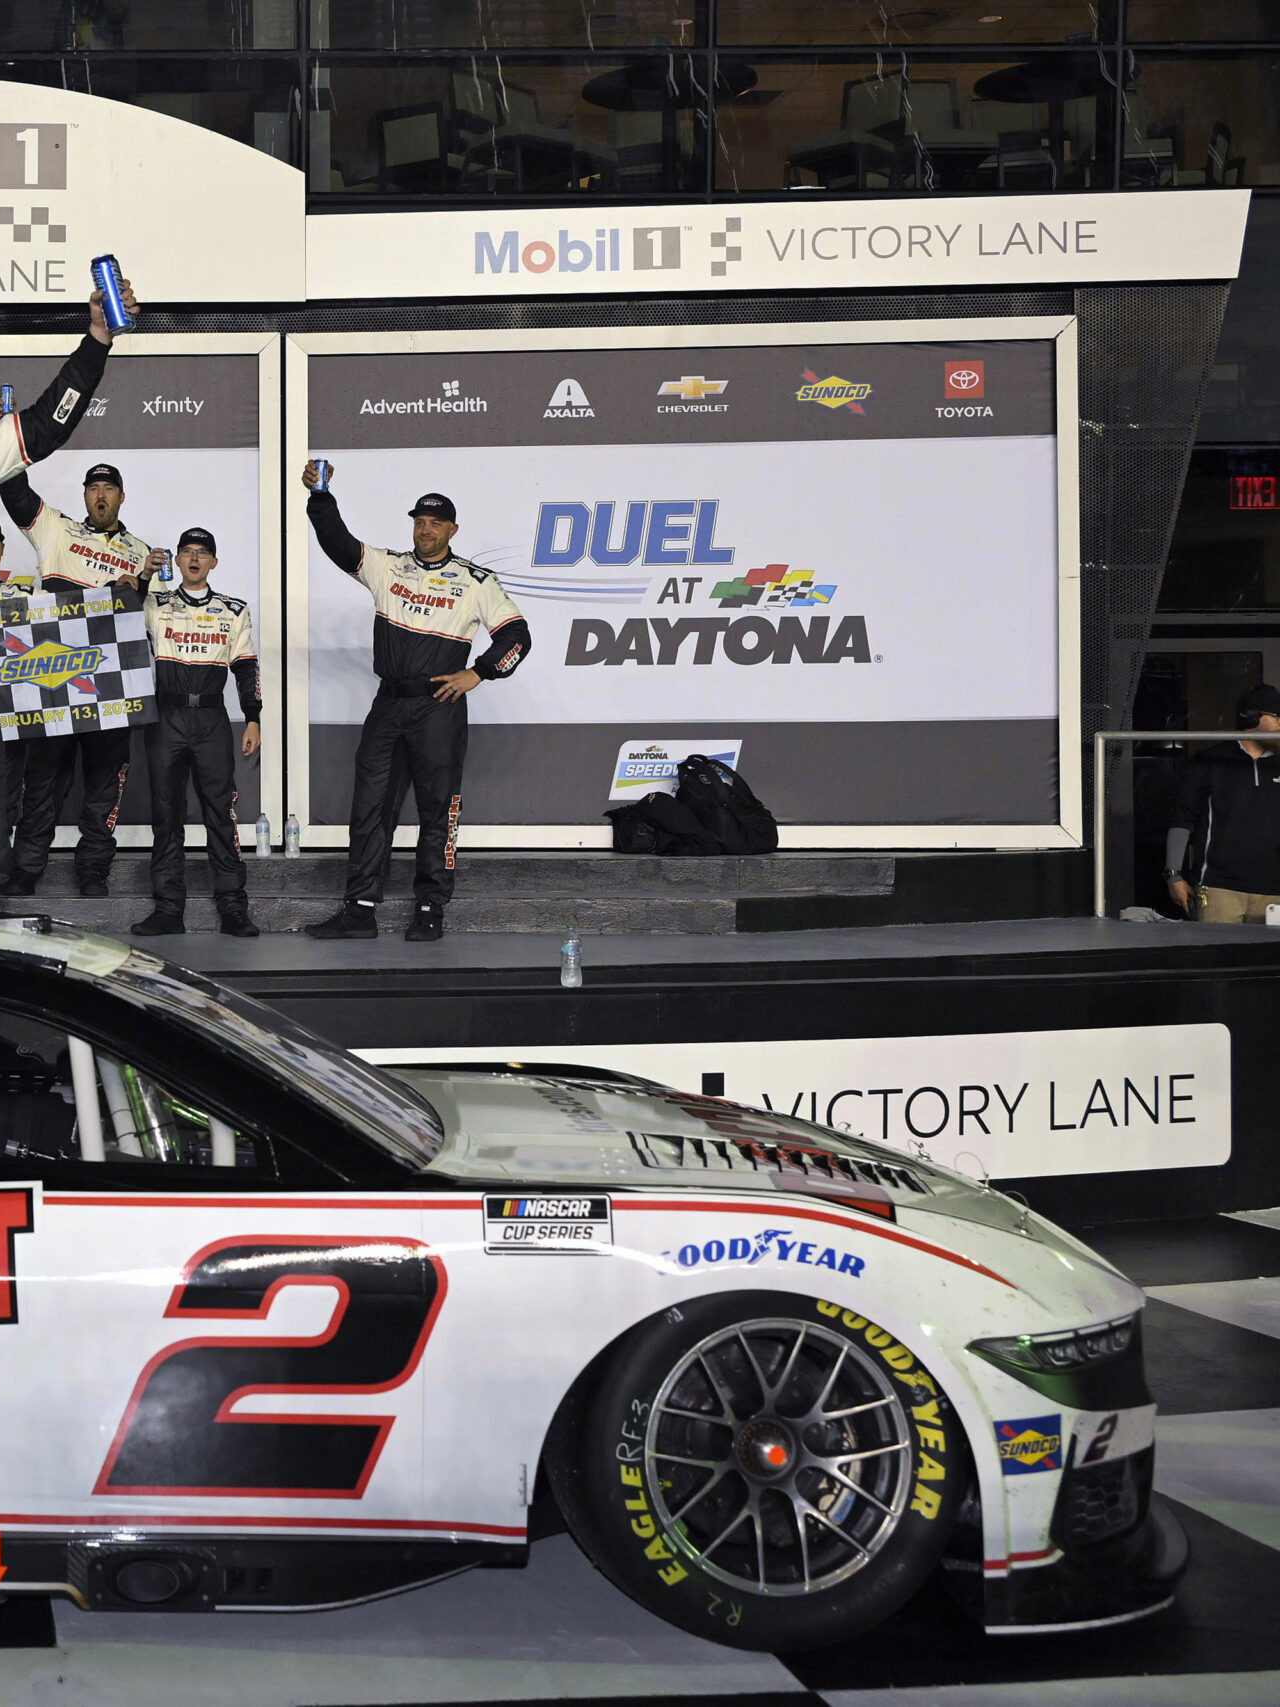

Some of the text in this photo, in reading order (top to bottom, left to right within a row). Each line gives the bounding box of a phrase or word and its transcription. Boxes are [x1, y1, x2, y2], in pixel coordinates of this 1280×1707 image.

[474, 229, 619, 274] Mobil
[766, 223, 962, 264] VICTORY
[977, 220, 1098, 257] LANE
[800, 385, 870, 401] SUNOCO
[142, 395, 204, 416] xfinity
[543, 408, 595, 418] AXALTA
[657, 404, 730, 413] CHEVROLET
[935, 407, 994, 418] TOYOTA
[531, 499, 736, 568] DUEL
[69, 543, 137, 575] DISCOUNT
[85, 559, 116, 575] TIRE
[389, 582, 456, 610] DISCOUNT
[657, 576, 703, 604] AT
[10, 611, 21, 623] 2
[25, 607, 45, 621] AT
[50, 598, 125, 618] DAYTONA
[401, 600, 431, 616] TIRE
[176, 645, 208, 653] TIRE
[564, 615, 872, 667] DAYTONA
[4, 650, 100, 680] SUNOCO
[72, 705, 98, 721] 13,
[102, 700, 143, 717] 2025
[624, 763, 679, 777] SPEED
[761, 1073, 1196, 1140] VICTORY LANE
[524, 1200, 592, 1218] NASCAR
[502, 1225, 594, 1242] CUP SERIES
[91, 1233, 448, 1500] 2
[1000, 1435, 1059, 1457] SUNOCO
[1081, 1412, 1119, 1465] 2
[620, 1464, 689, 1587] EAGLE
